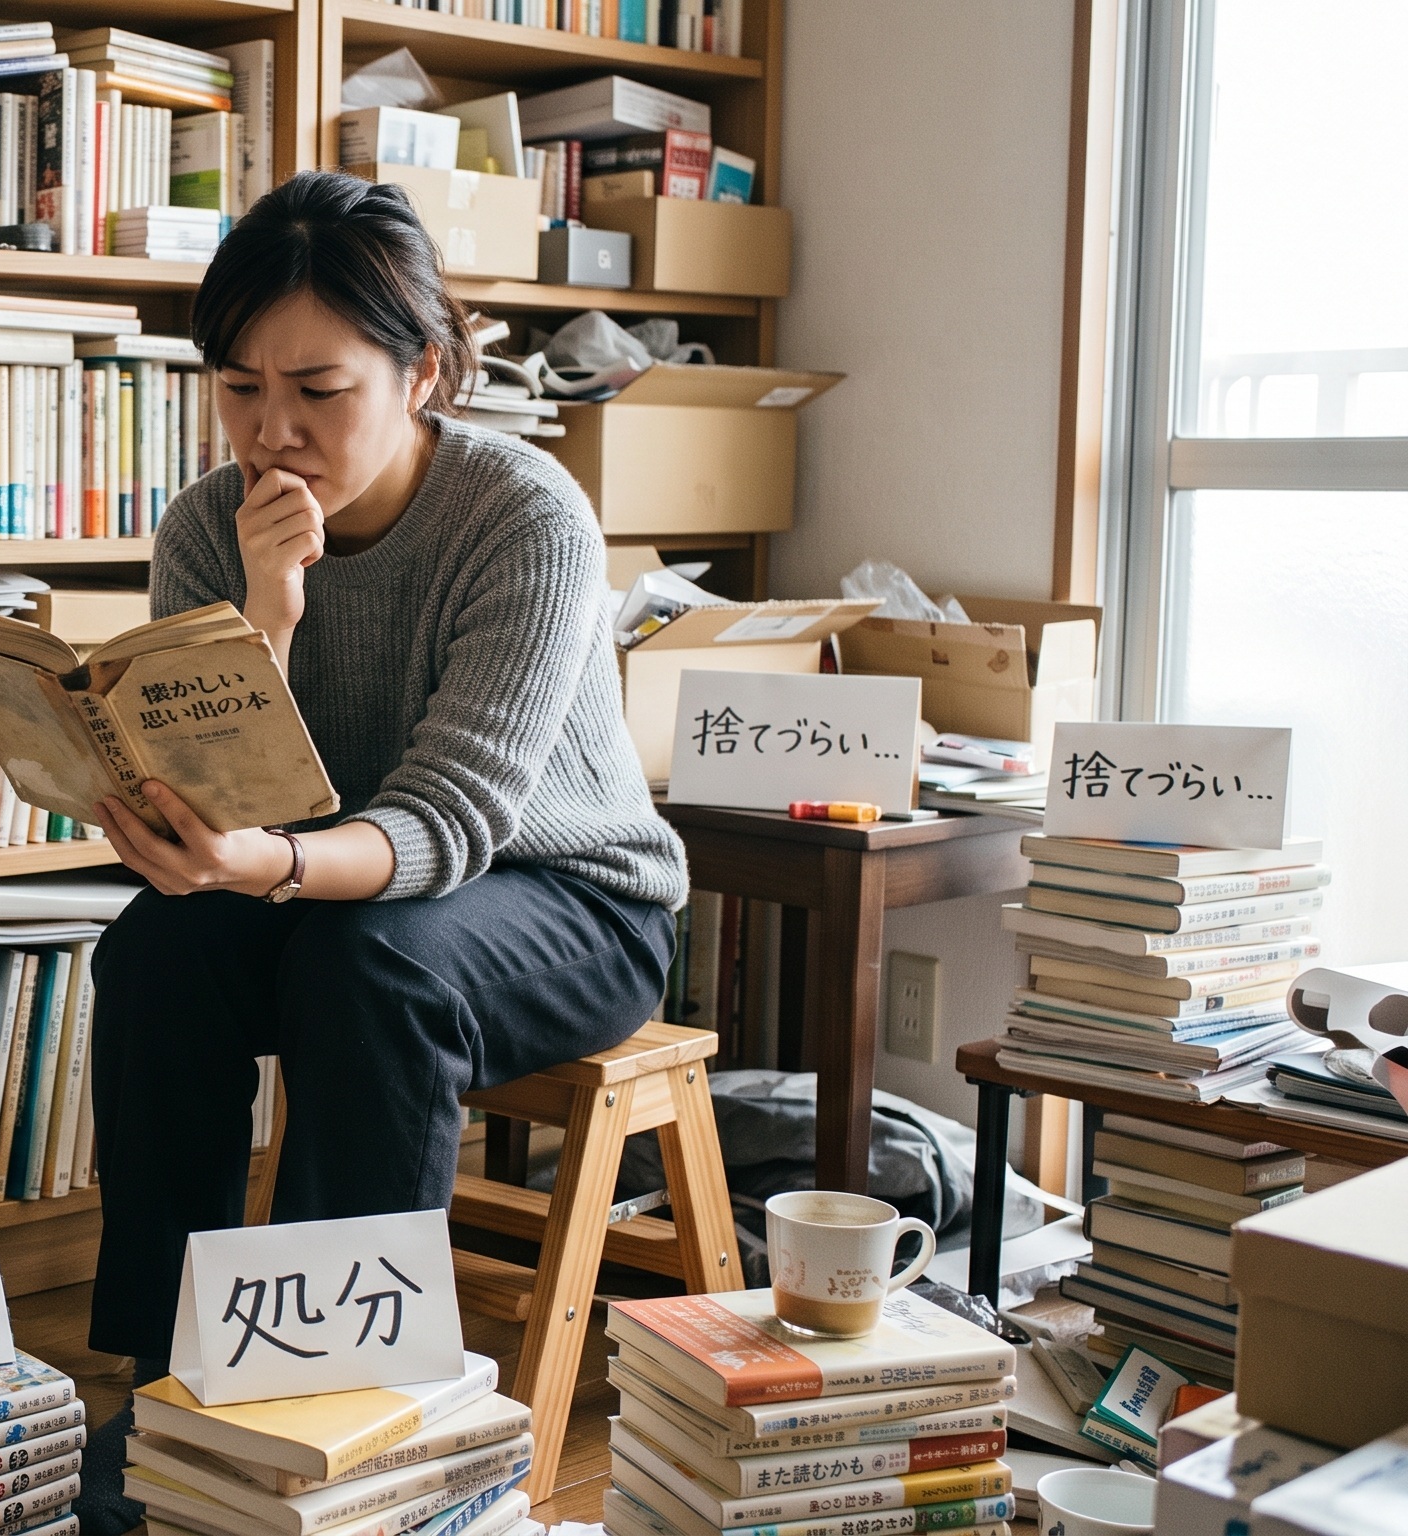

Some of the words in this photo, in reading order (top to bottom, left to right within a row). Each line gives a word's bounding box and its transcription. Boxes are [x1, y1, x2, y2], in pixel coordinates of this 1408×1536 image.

[141, 672, 245, 706] 懐かしい
[139, 691, 271, 730] 思い出の本
[221, 1256, 423, 1368] 処分
[757, 1456, 865, 1489] また読むかも
